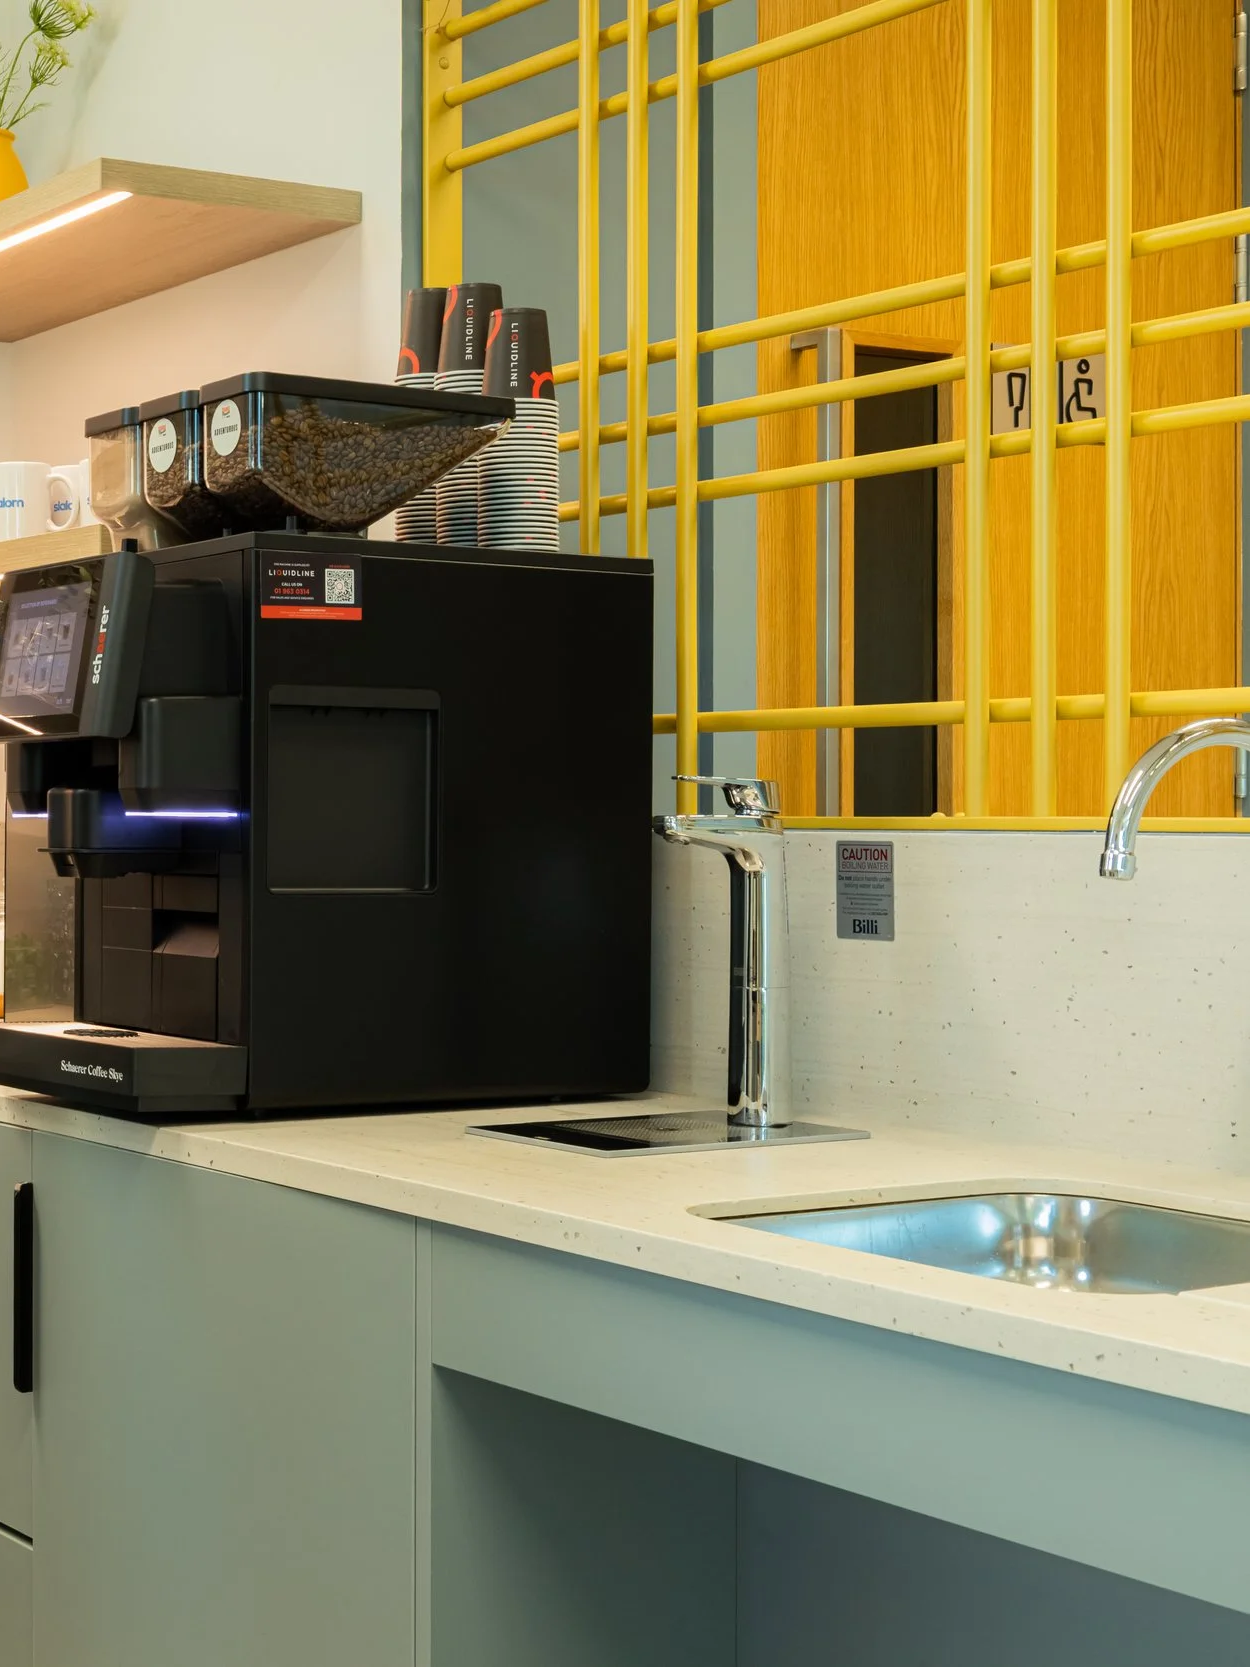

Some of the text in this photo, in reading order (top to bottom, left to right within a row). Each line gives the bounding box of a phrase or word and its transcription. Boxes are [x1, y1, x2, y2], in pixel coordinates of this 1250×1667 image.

[465, 298, 474, 360] LIQUIDLINE
[510, 322, 519, 387] LIQUIDLINE
[214, 423, 238, 436] ADVENTUROUS
[151, 441, 174, 454] ADVENTUROUS
[268, 569, 316, 578] LIQUIDLINE
[92, 605, 111, 684] schaerer
[842, 848, 888, 861] CAUTION
[842, 861, 889, 870] BOILING WATER
[852, 918, 878, 934] Billi
[60, 1059, 124, 1083] Schaerer Coffee Skye
